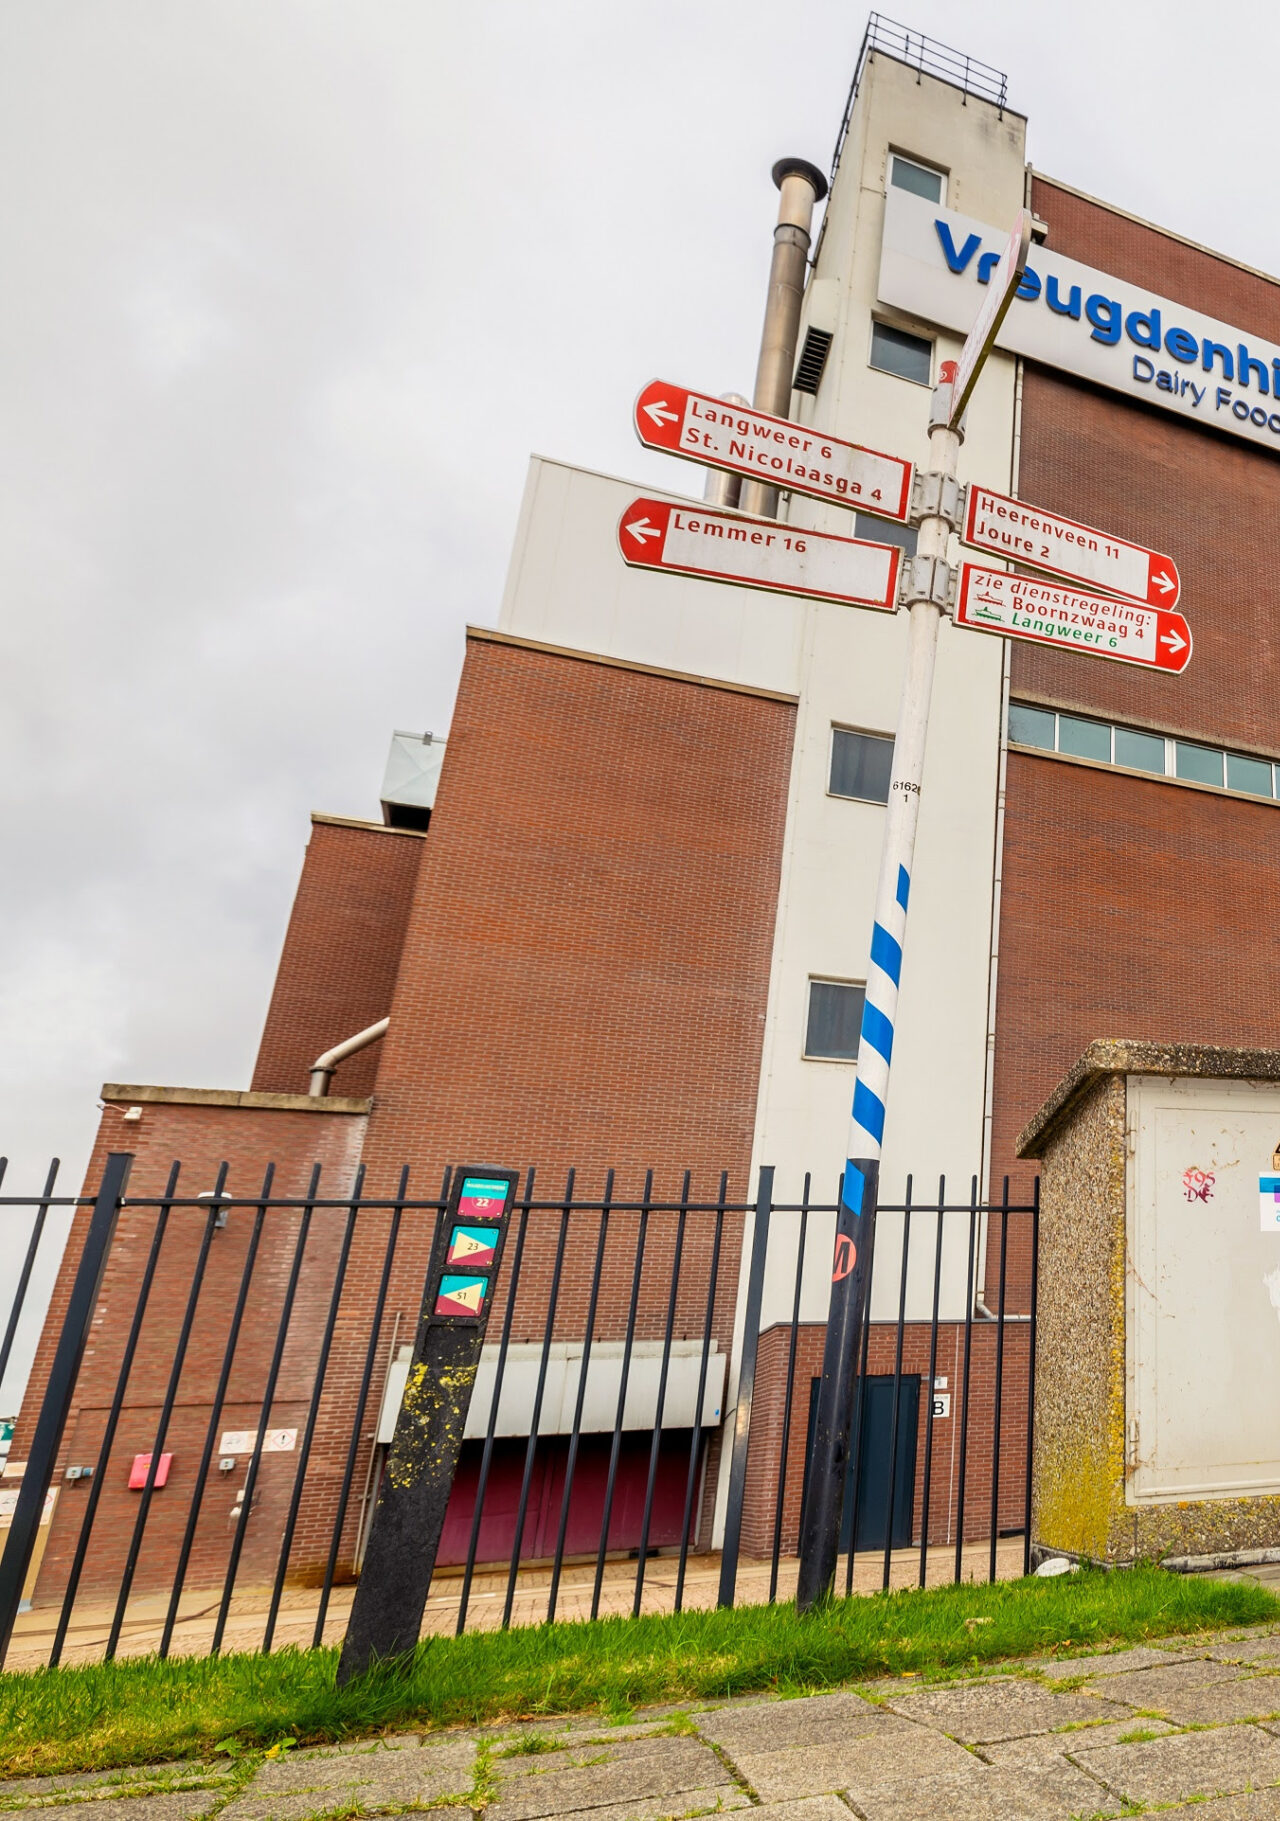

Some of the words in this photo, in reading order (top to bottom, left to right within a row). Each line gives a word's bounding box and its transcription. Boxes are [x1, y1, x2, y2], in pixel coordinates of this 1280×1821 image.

[1133, 354, 1206, 407] Dairy
[691, 401, 813, 452] Langweer
[820, 446, 833, 459] 6
[685, 427, 719, 451] St.
[729, 440, 862, 495] Nicolaasga
[871, 488, 883, 501] 4
[674, 514, 776, 547] Lemmer
[783, 538, 807, 553] 16
[977, 521, 1034, 552] Joure
[1040, 545, 1050, 558] 2
[981, 497, 1098, 552] Heerenveen
[1105, 545, 1120, 560] 11
[974, 574, 1003, 590] zie
[1010, 581, 1152, 627] dienstregeling:
[1012, 596, 1129, 638] Boornzwaag
[1135, 628, 1144, 639] 4
[1011, 612, 1103, 644] Langweer
[1108, 637, 1118, 648] 6
[903, 794, 908, 803] 1
[476, 1198, 489, 1207] 22
[467, 1242, 479, 1251] 23
[456, 1292, 467, 1300] 51
[932, 1401, 945, 1416] B
